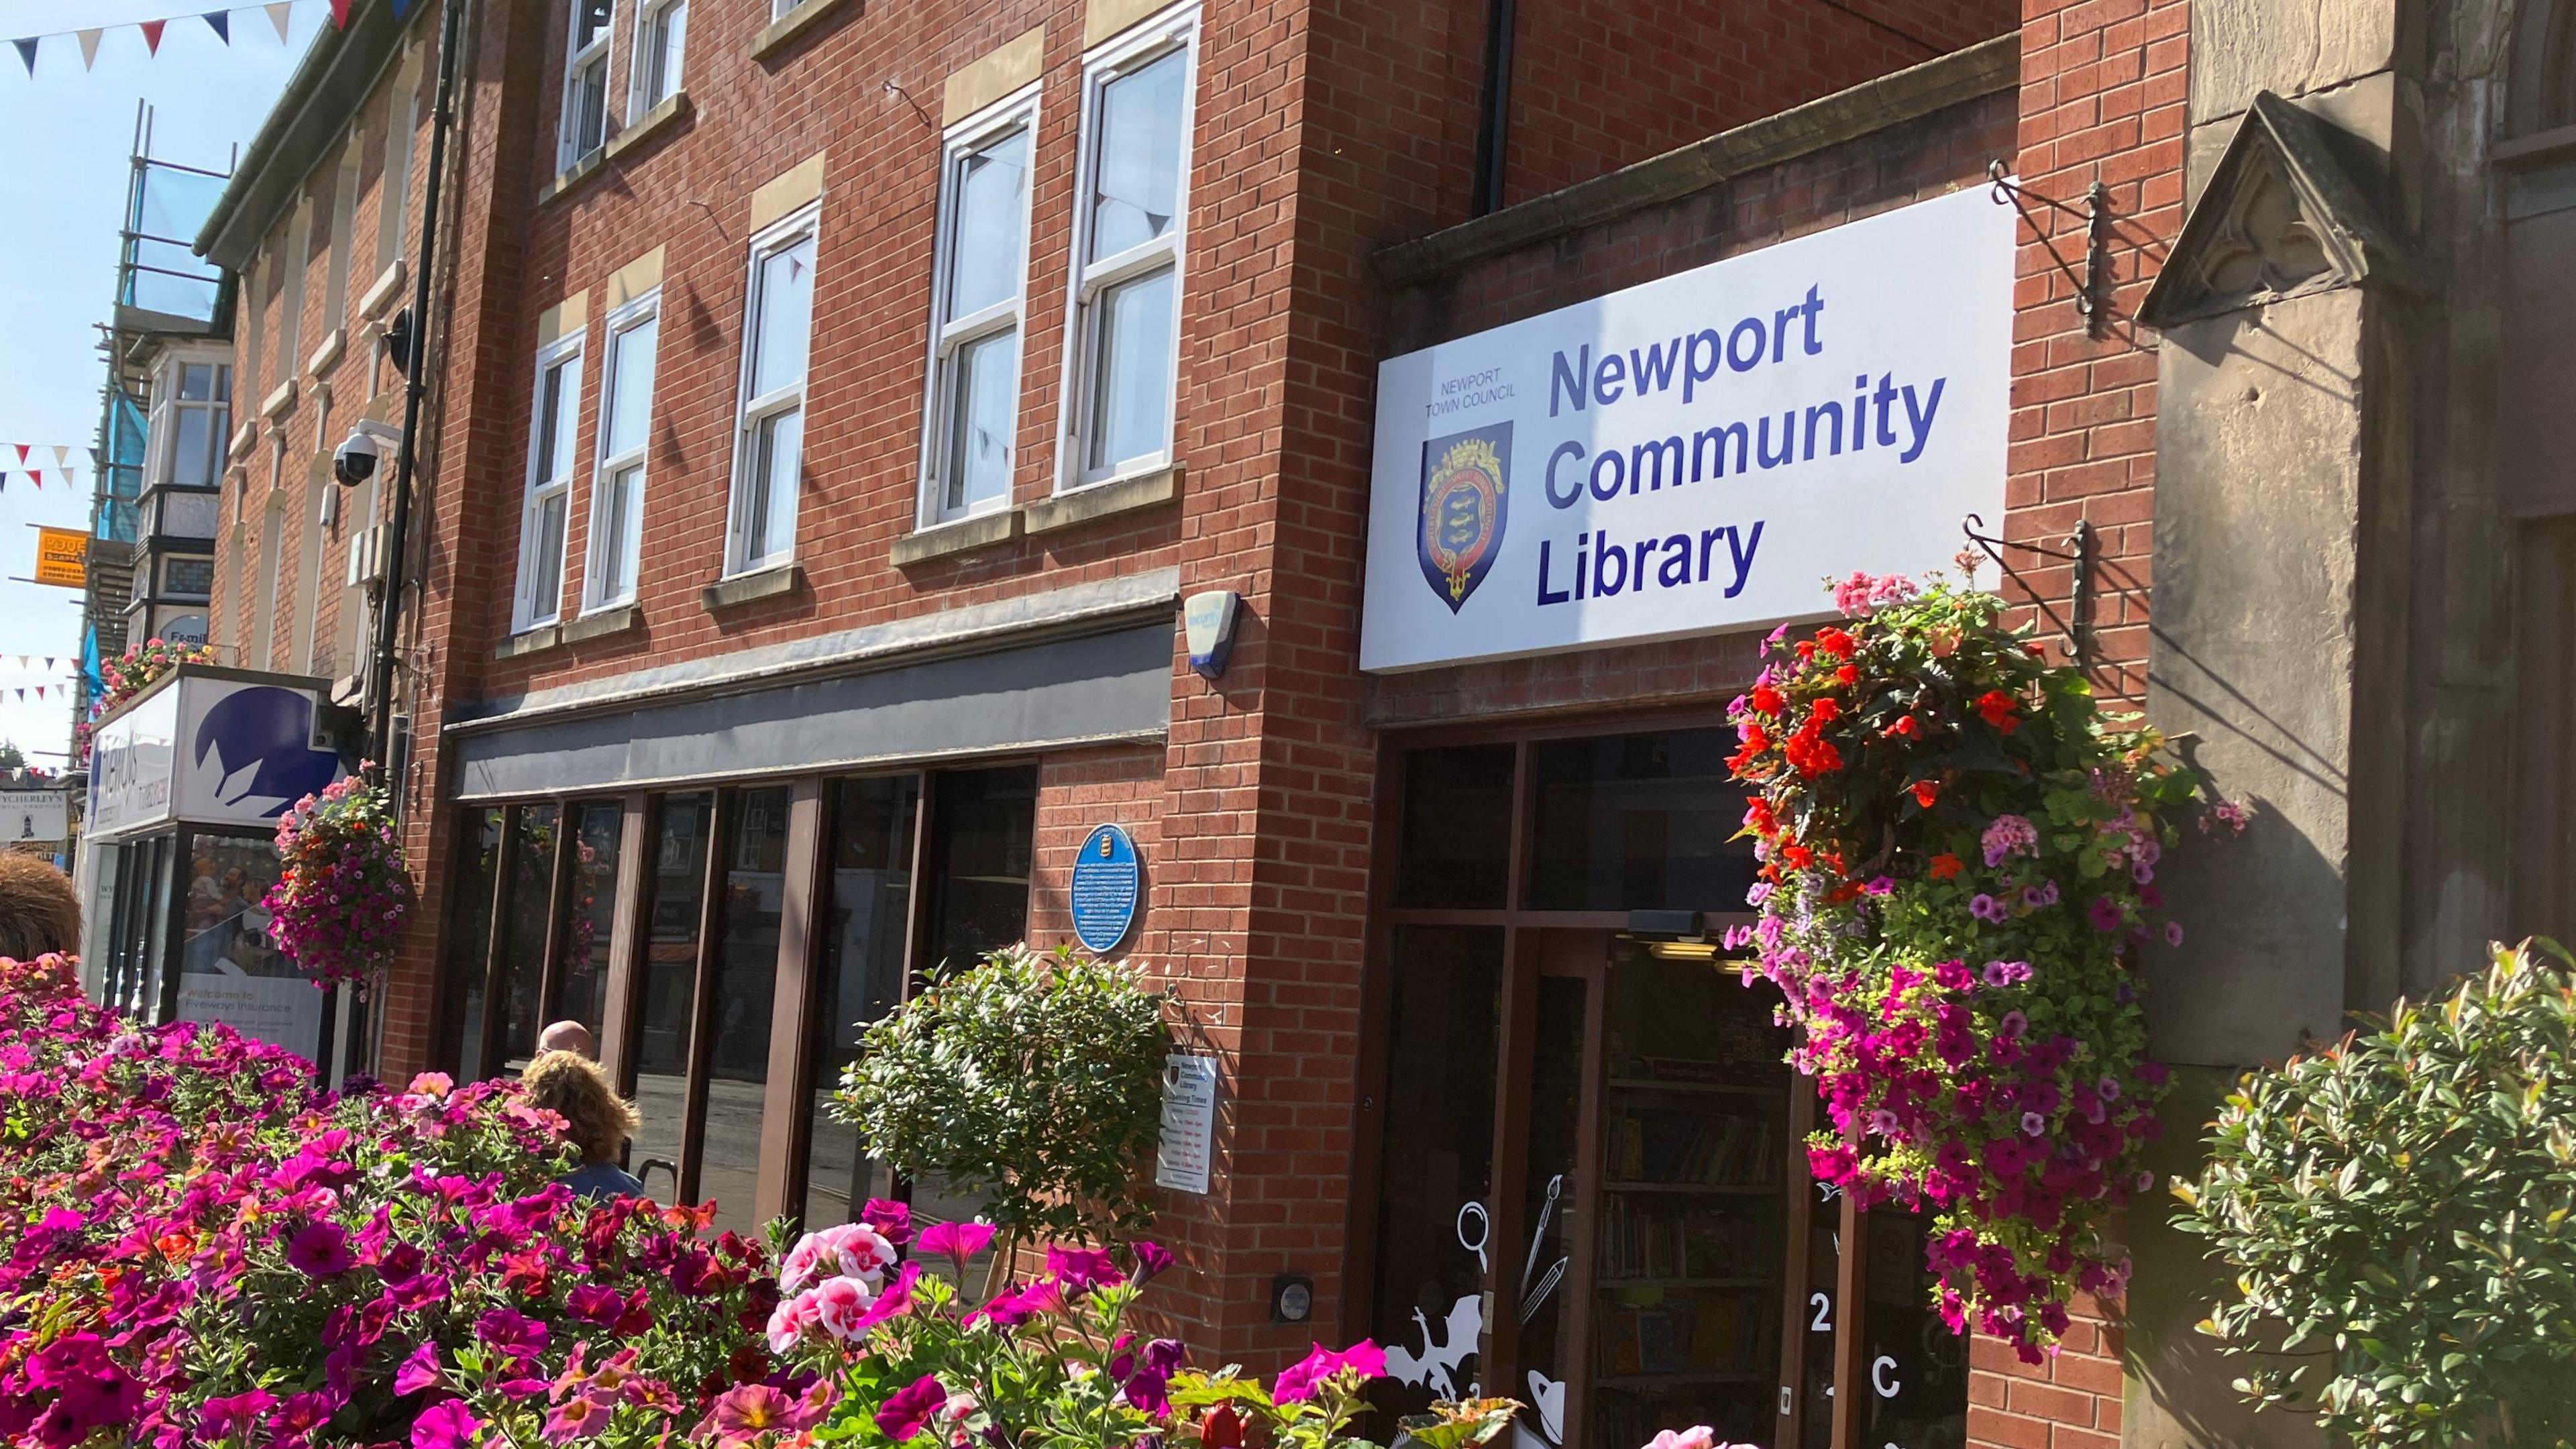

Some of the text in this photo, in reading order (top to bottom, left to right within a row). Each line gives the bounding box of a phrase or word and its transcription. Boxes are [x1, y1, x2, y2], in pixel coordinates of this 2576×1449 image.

[1550, 282, 1824, 417] Newport
[1440, 368, 1501, 396] NEWPORT
[1426, 383, 1516, 419] TOWN COUNCIL
[1545, 371, 1947, 509] Community
[1536, 521, 1766, 606] Library
[170, 631, 207, 644] Famil
[0, 794, 62, 803] YCHERLEY'S
[185, 1000, 292, 1013] Fiveways Insurance
[187, 989, 254, 1000] Welcome to
[1191, 1094, 1207, 1104] Times
[1810, 1292, 1831, 1332] 2
[1872, 1355, 1901, 1398] C
